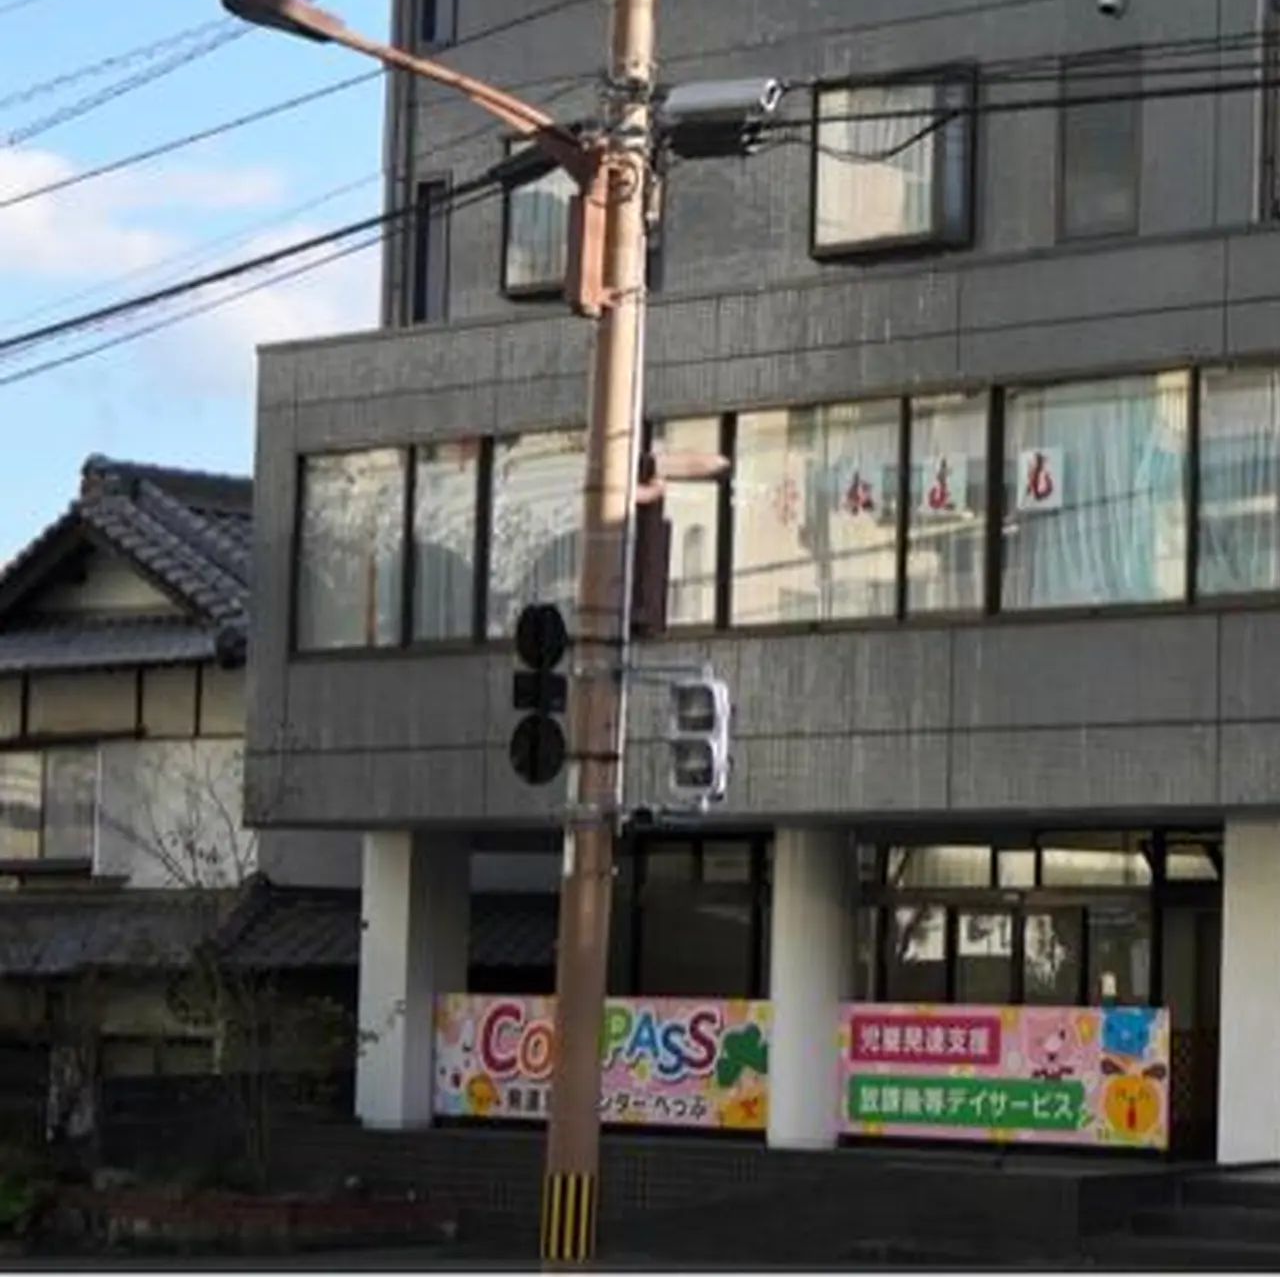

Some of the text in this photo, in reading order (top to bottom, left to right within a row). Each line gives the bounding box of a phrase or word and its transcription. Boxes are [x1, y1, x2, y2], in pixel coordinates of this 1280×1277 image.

[480, 1003, 718, 1075] COPASS
[859, 1085, 1074, 1120] 放課後等デイサービス
